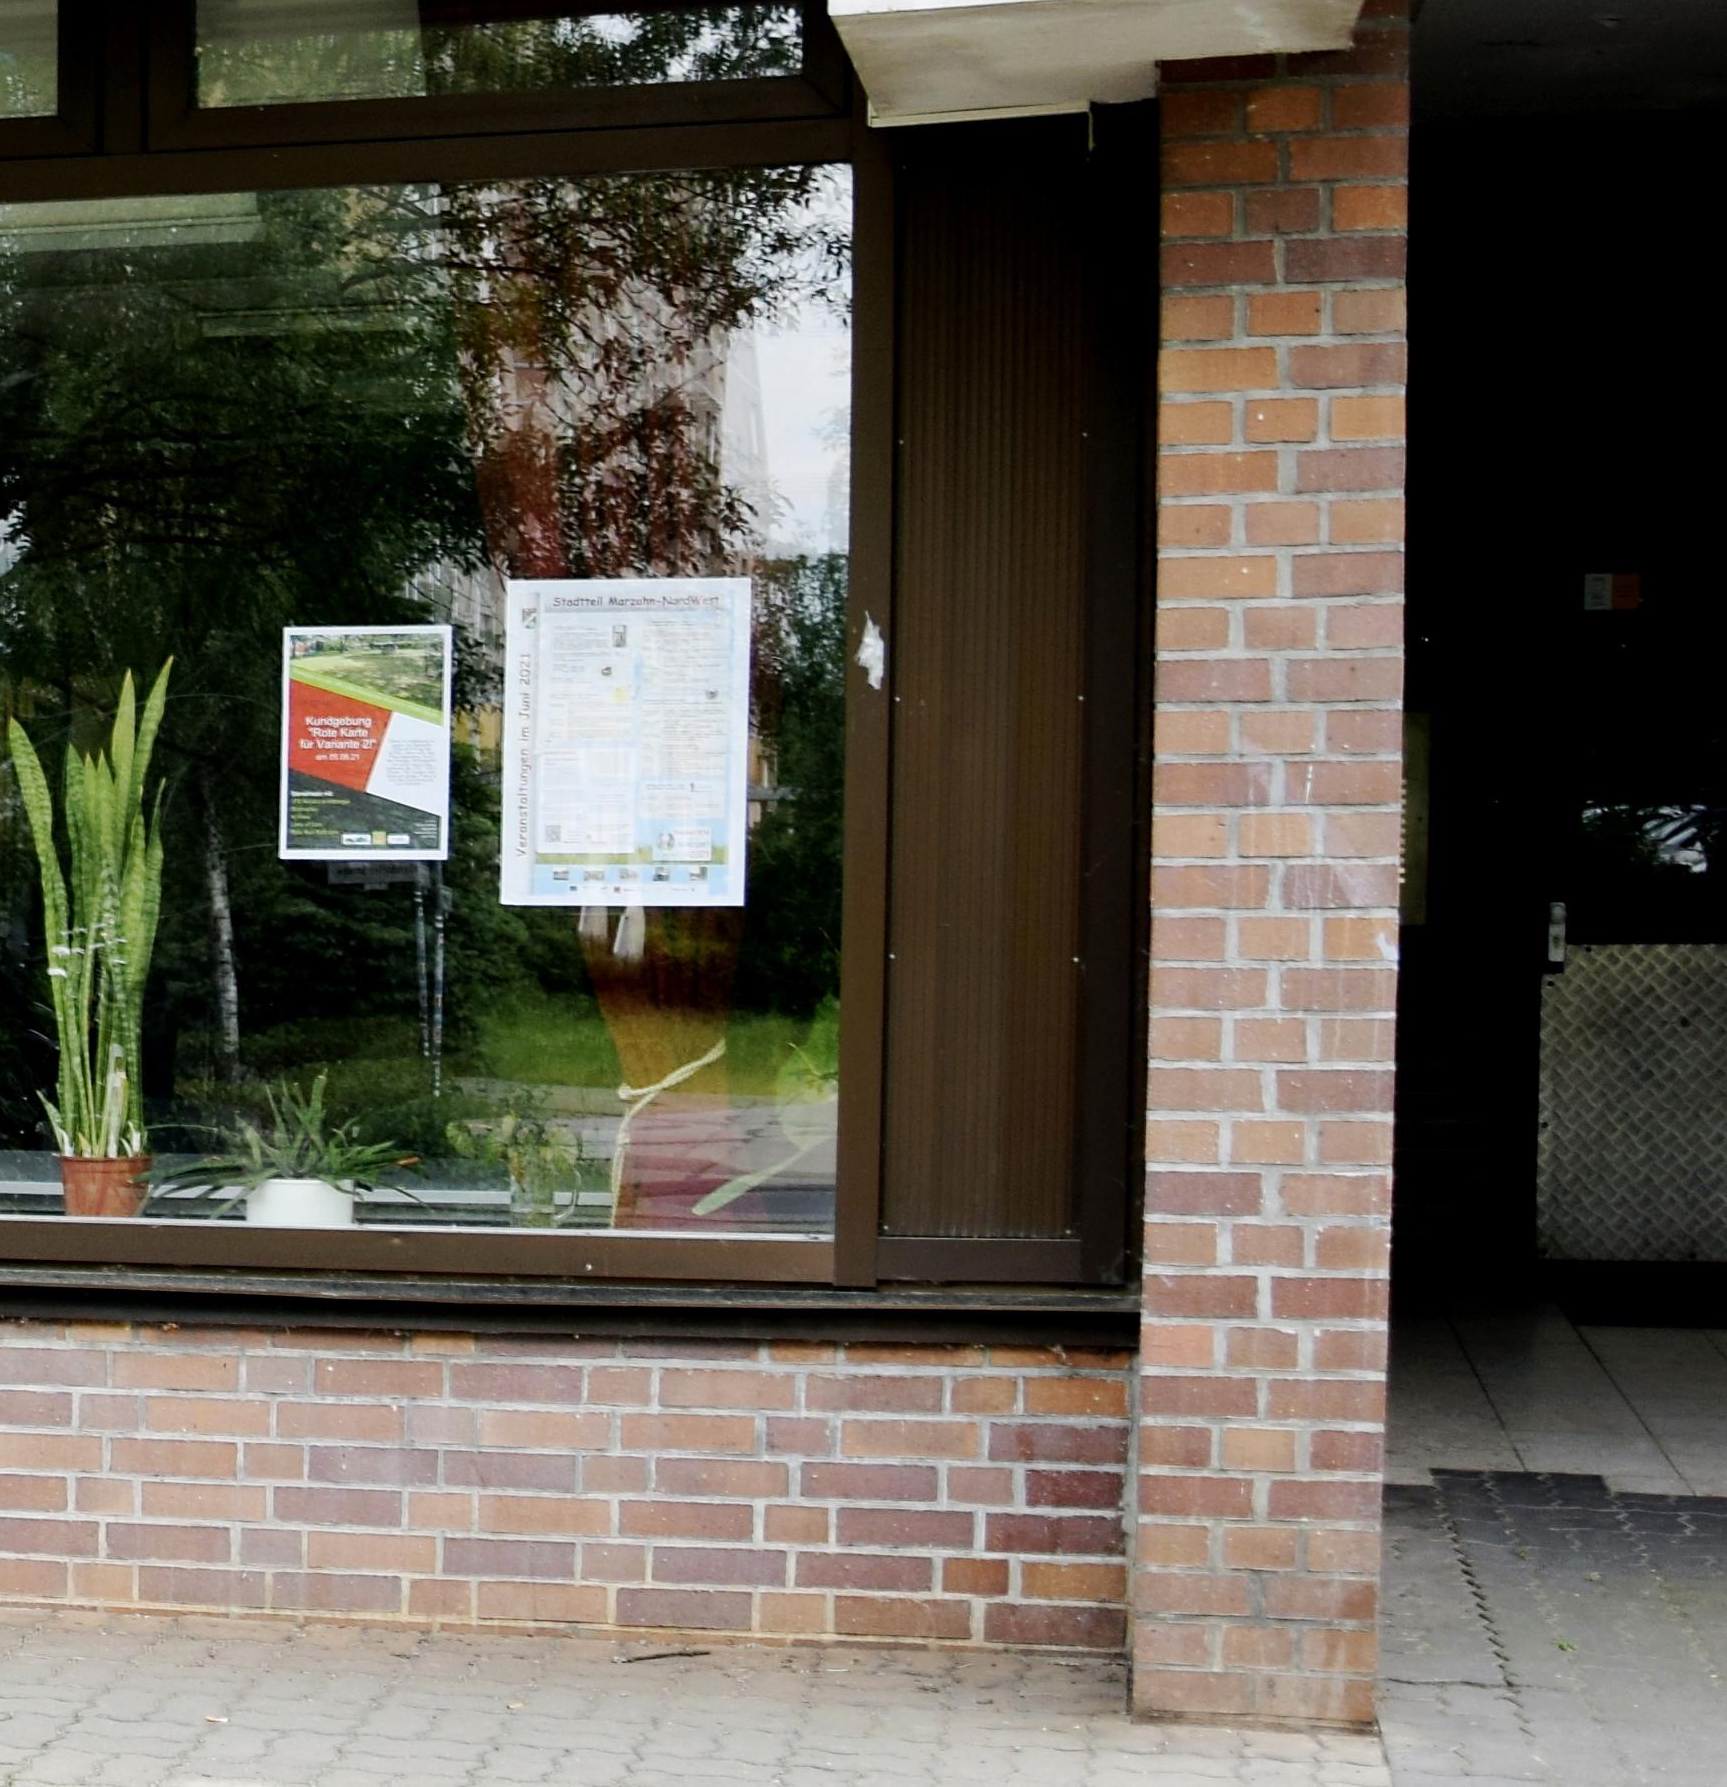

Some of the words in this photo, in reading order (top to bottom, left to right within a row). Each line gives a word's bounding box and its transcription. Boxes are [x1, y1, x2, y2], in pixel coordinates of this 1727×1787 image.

[553, 595, 603, 607] Stadtteil
[519, 653, 531, 686] 2021
[518, 692, 531, 720] Juni
[305, 716, 373, 728] Kundgebung
[340, 727, 369, 738] Karte
[519, 727, 530, 742] im
[316, 739, 360, 749] Variante
[516, 748, 531, 857] Veranstaltungen
